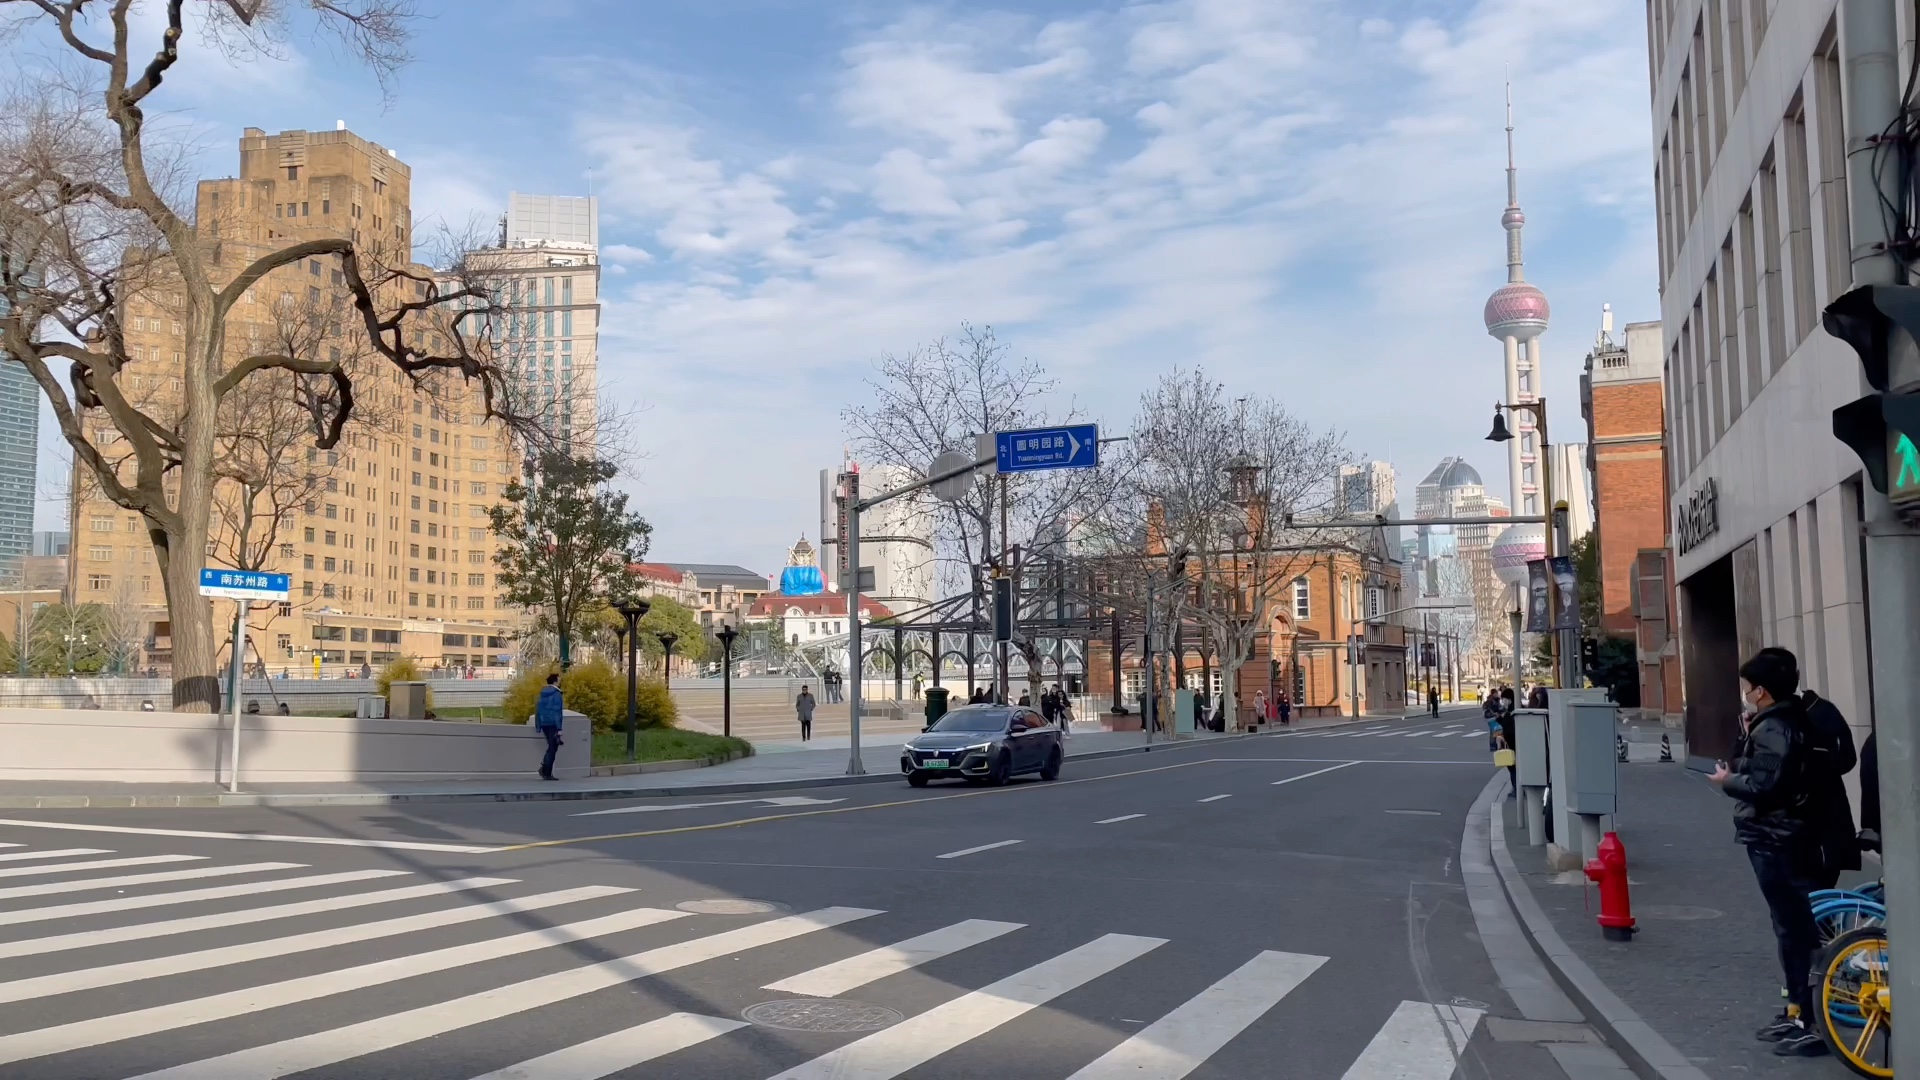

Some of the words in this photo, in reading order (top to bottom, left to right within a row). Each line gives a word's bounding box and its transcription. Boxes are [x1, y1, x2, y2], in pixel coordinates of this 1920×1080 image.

[205, 571, 213, 579] 西
[221, 573, 268, 588] 南苏州路
